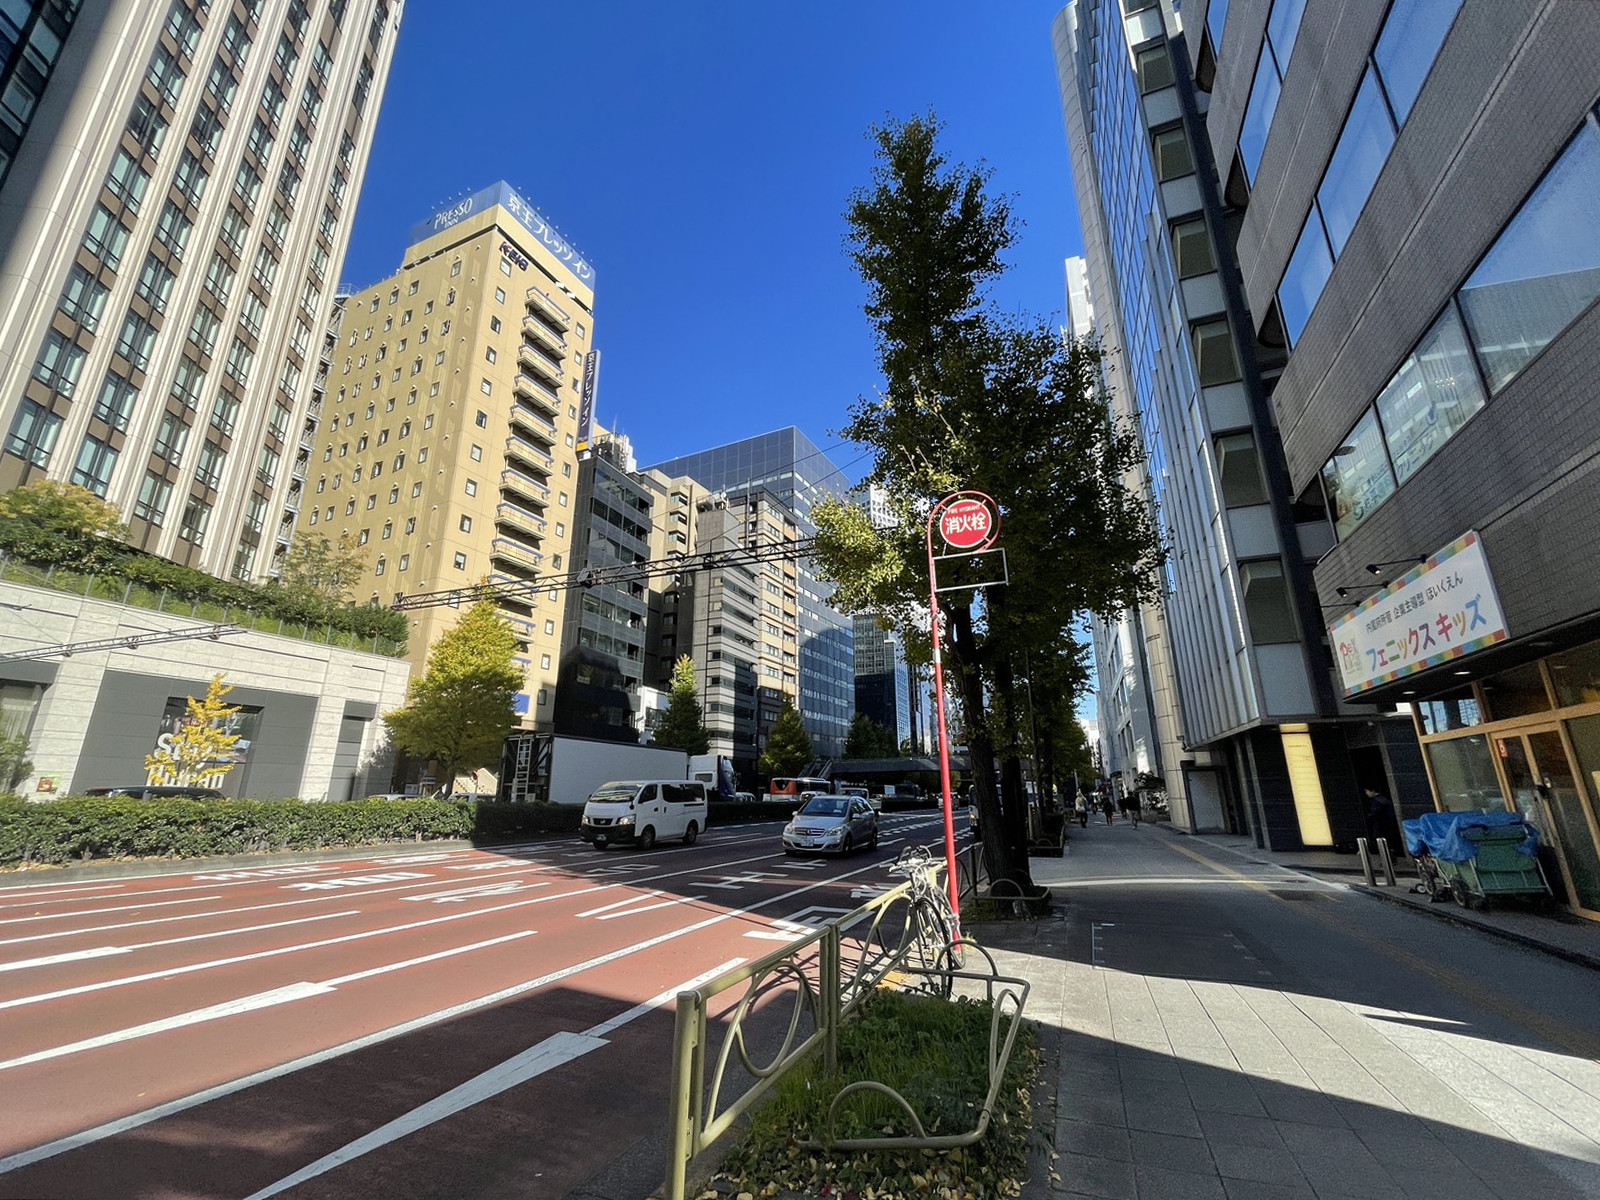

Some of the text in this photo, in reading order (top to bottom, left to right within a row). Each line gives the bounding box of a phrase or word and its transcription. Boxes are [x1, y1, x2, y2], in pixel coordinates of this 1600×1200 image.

[434, 198, 473, 229] PRESSO
[508, 193, 591, 279] 京王プレッソイン
[499, 241, 529, 271] KEIO
[581, 353, 595, 427] 京王プレッソイン
[945, 511, 987, 535] 消火栓
[1426, 571, 1464, 601] ほいくえん
